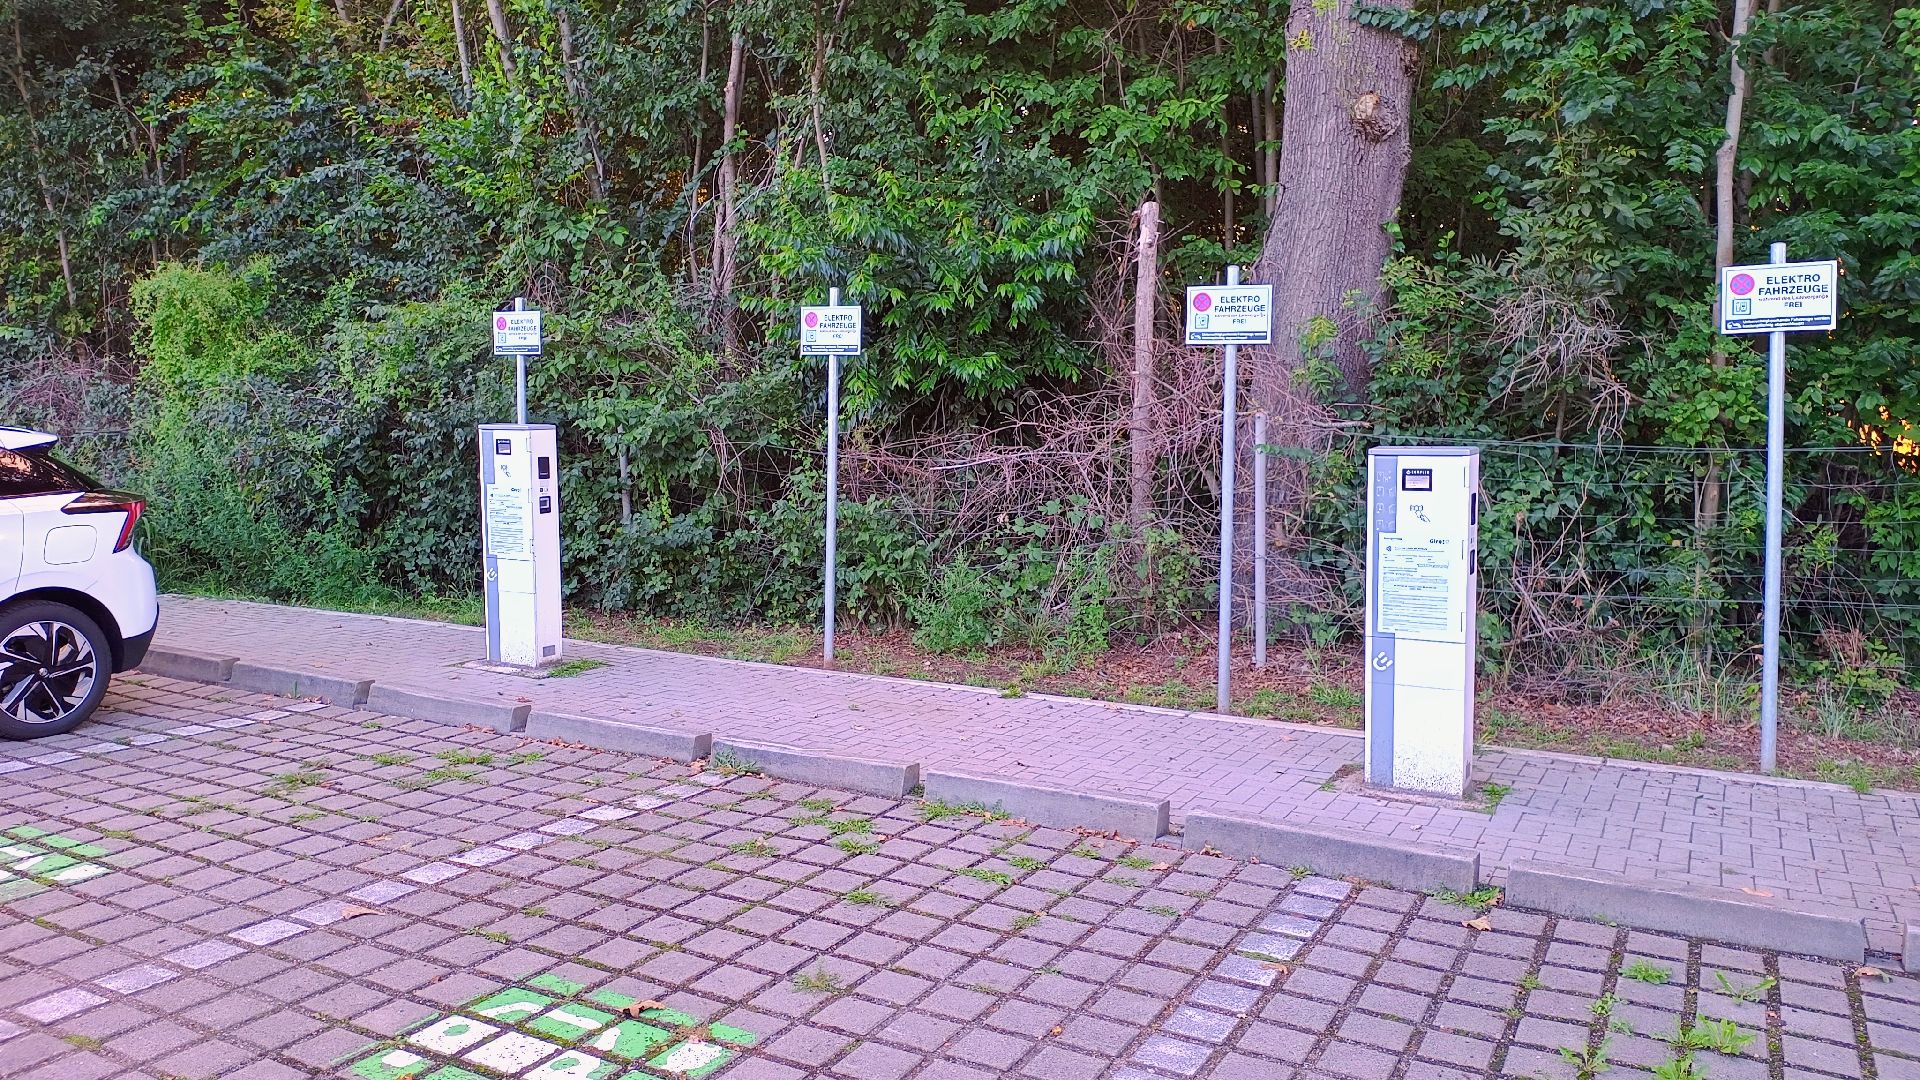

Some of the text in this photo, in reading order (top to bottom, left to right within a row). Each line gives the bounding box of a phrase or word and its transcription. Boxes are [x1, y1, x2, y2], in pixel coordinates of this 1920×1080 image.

[1766, 274, 1820, 284] ELEKTRO
[1758, 284, 1828, 296] FAHRZEUGE
[1220, 296, 1260, 304] ELEKTRO
[1214, 304, 1266, 312] FAHRZEUGE
